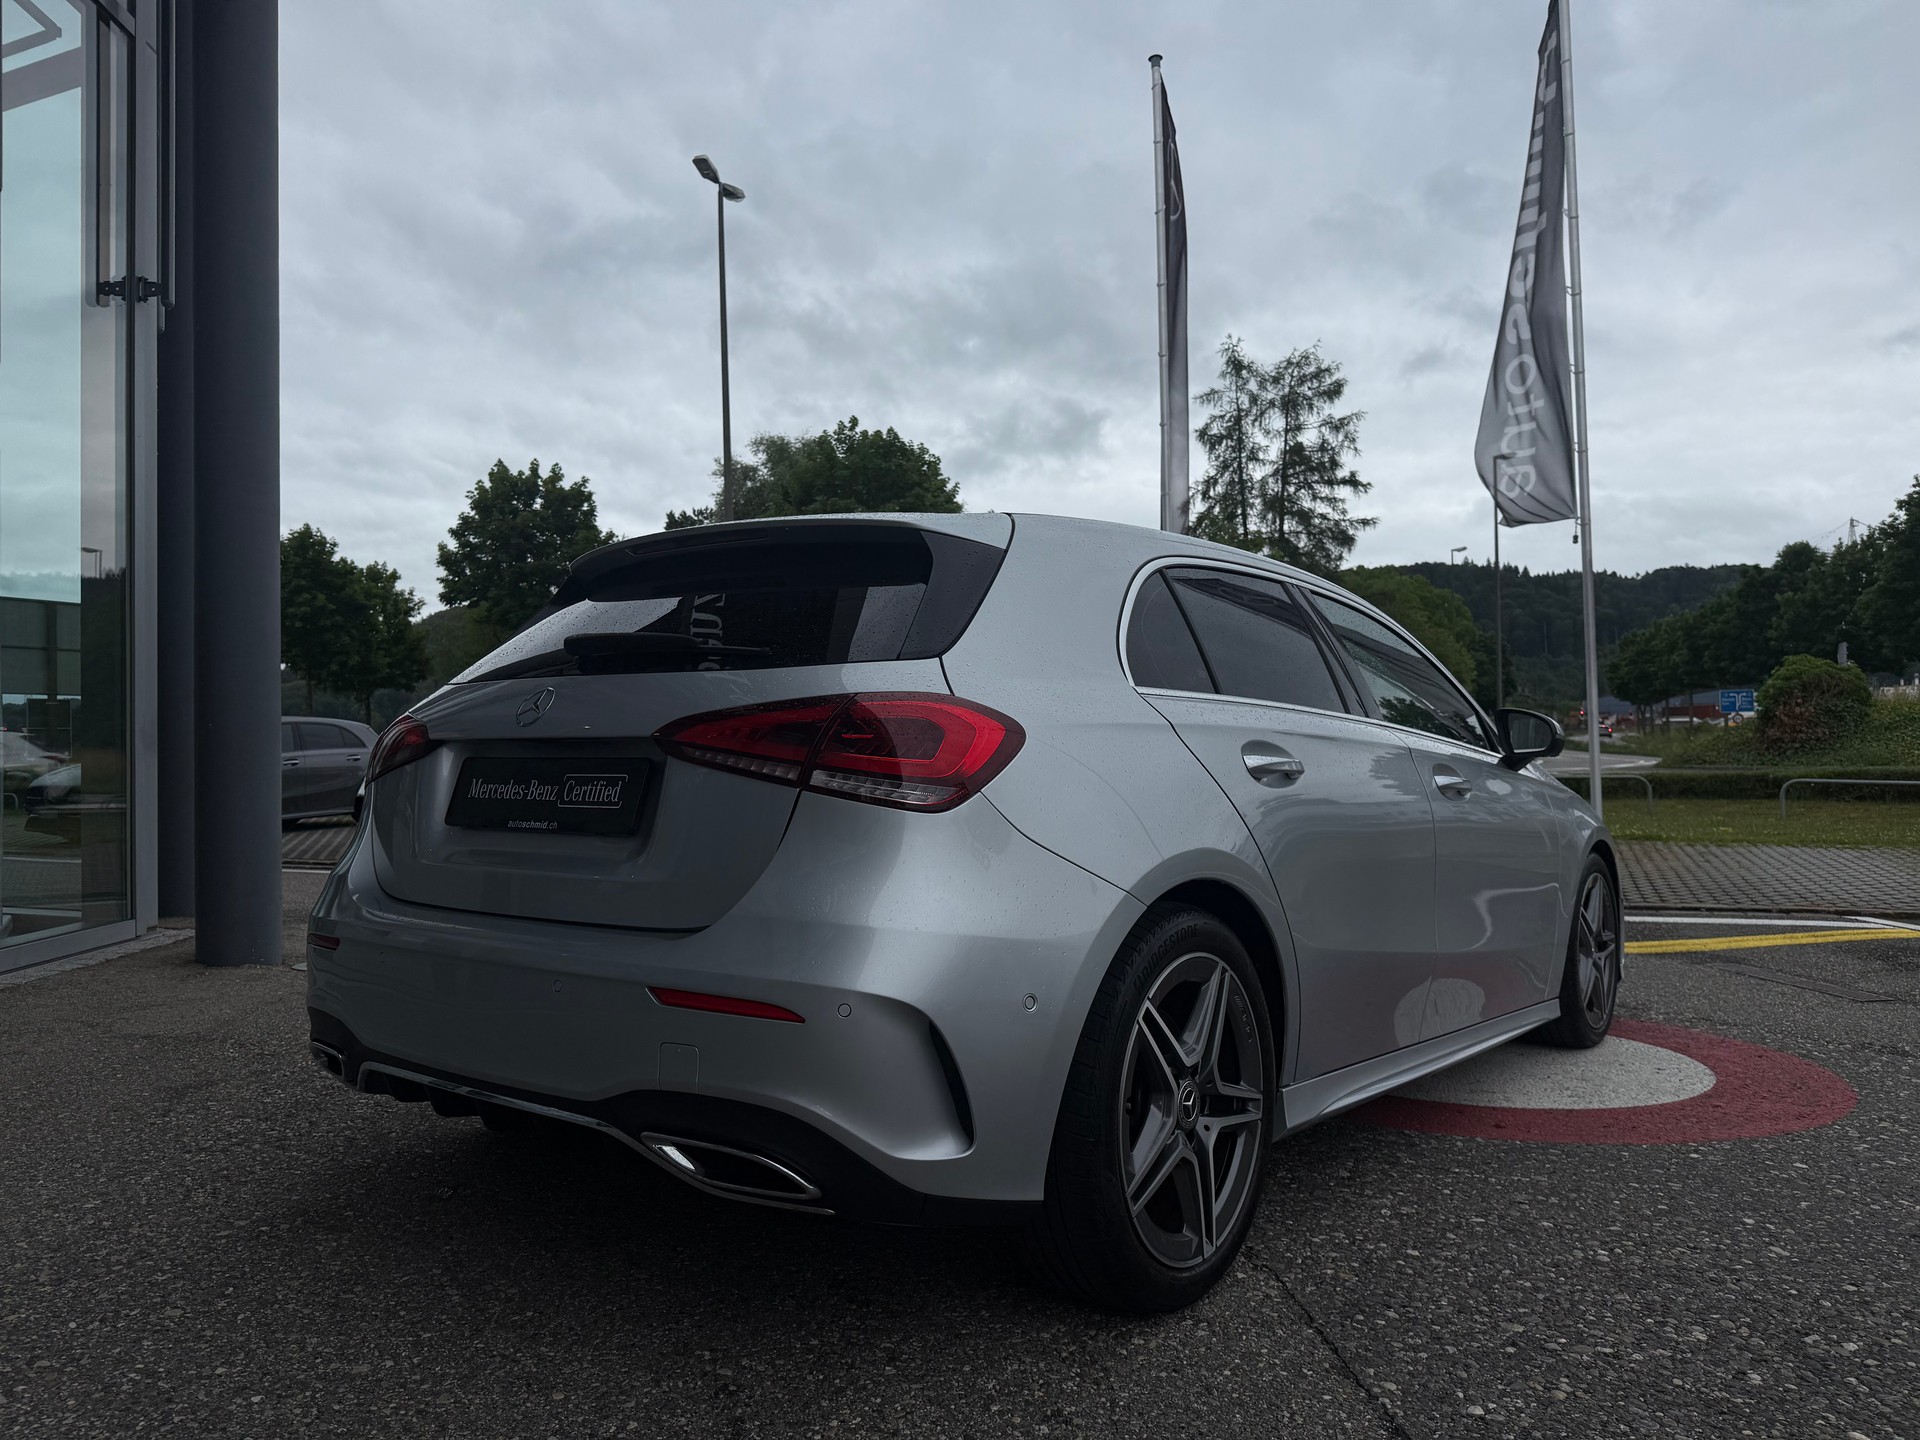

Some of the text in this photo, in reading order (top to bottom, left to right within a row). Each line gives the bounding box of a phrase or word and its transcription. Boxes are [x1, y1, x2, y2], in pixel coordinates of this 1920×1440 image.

[467, 778, 622, 802] Mercedes-Benz Certified
[507, 820, 558, 830] autoschmid.ch
